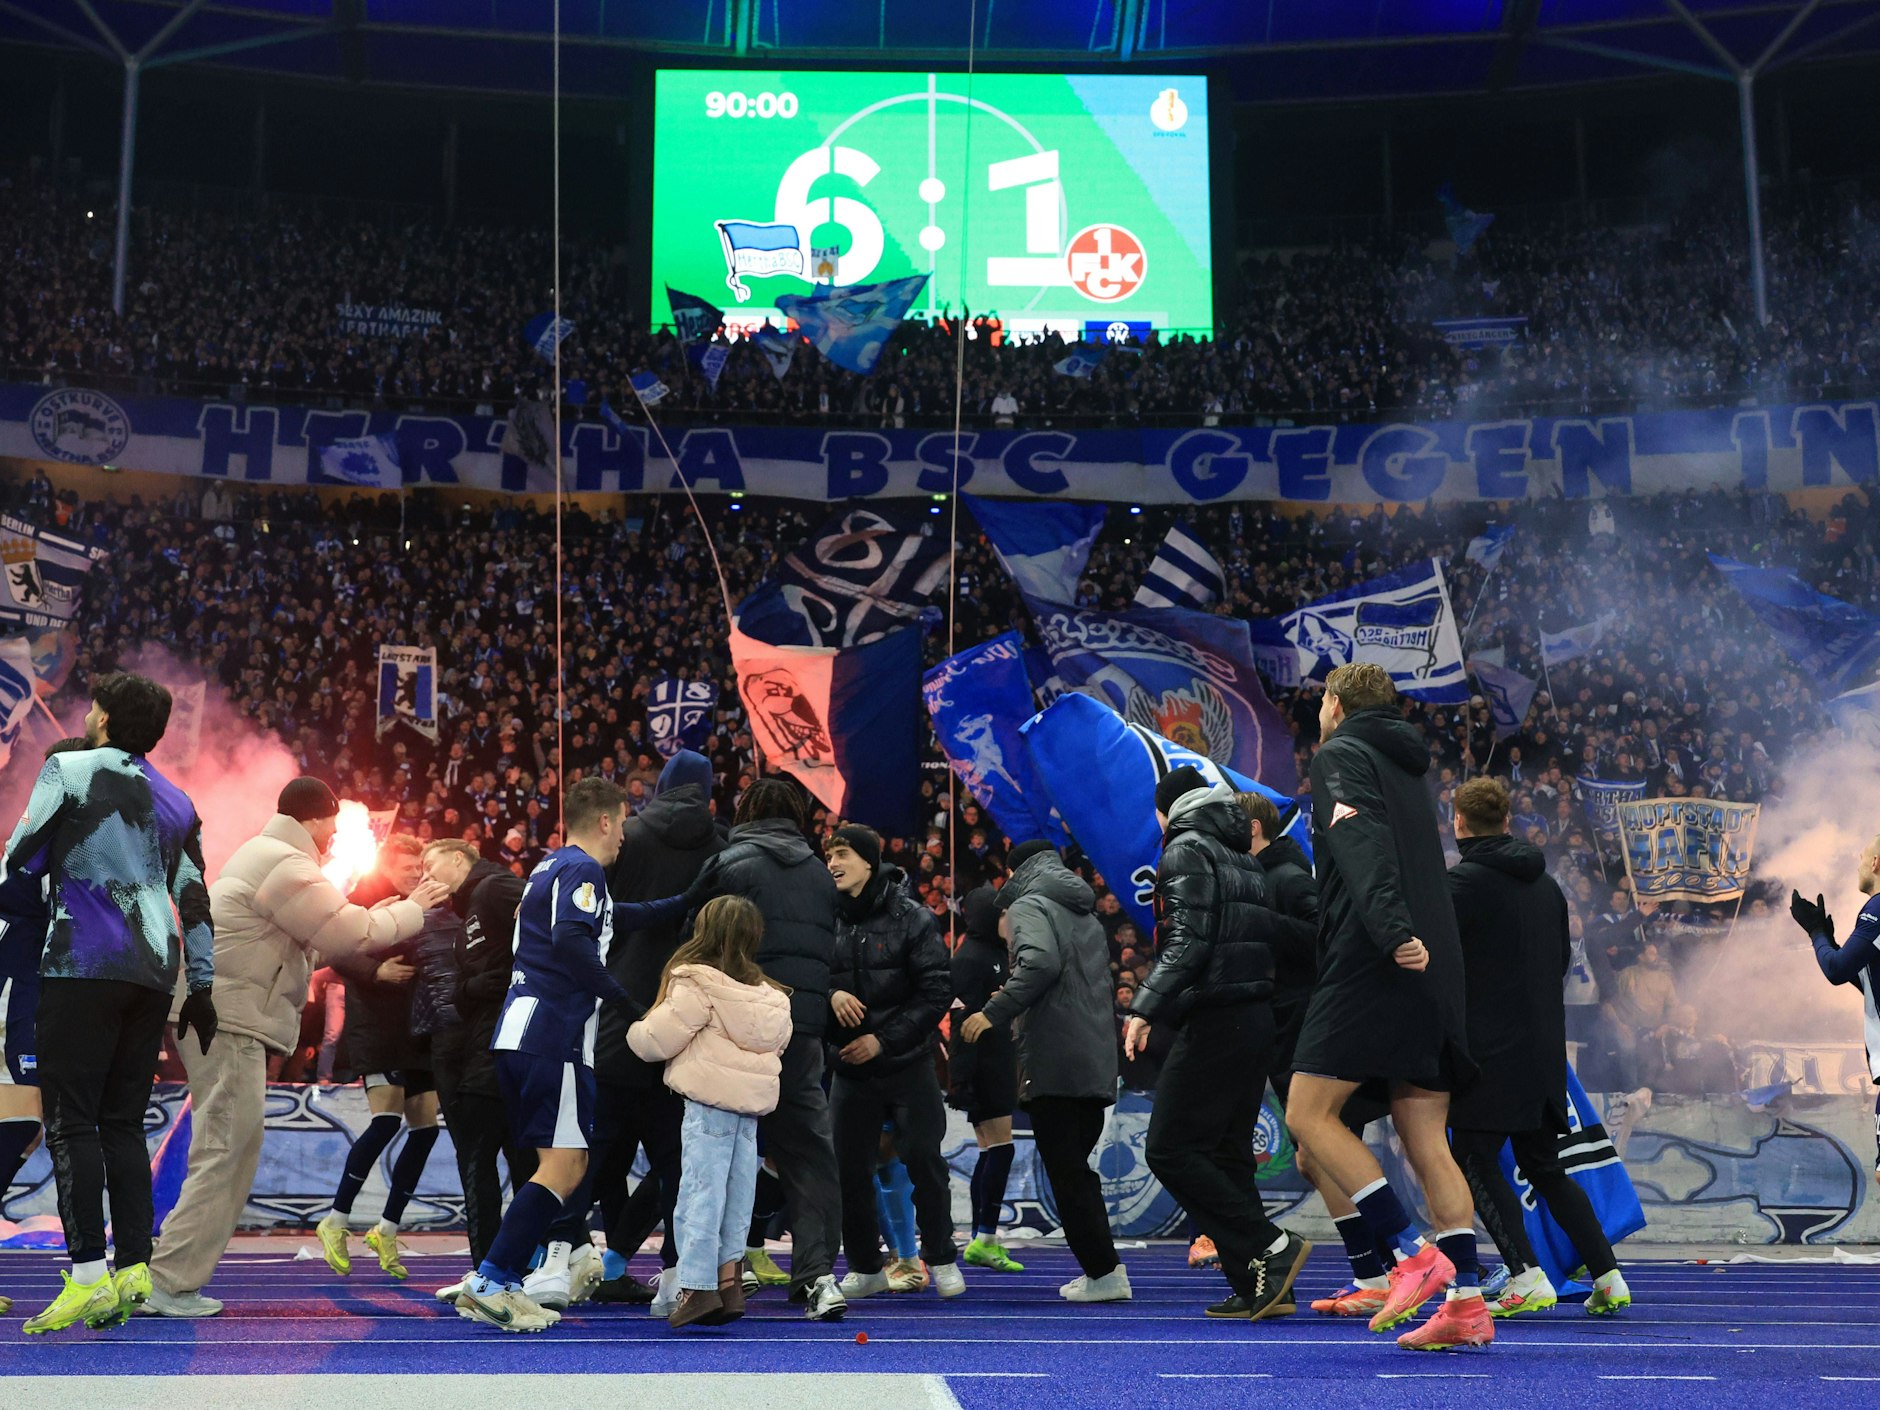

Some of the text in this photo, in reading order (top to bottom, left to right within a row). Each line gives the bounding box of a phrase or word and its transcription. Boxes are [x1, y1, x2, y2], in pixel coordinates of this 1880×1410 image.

[705, 91, 799, 118] 90:00
[774, 145, 885, 286] 6
[987, 149, 1072, 286] 1
[41, 393, 120, 423] OSTKURVE
[820, 429, 1077, 499] BSC
[1166, 415, 1635, 501] GEGEN
[0, 513, 36, 537] BERLIN
